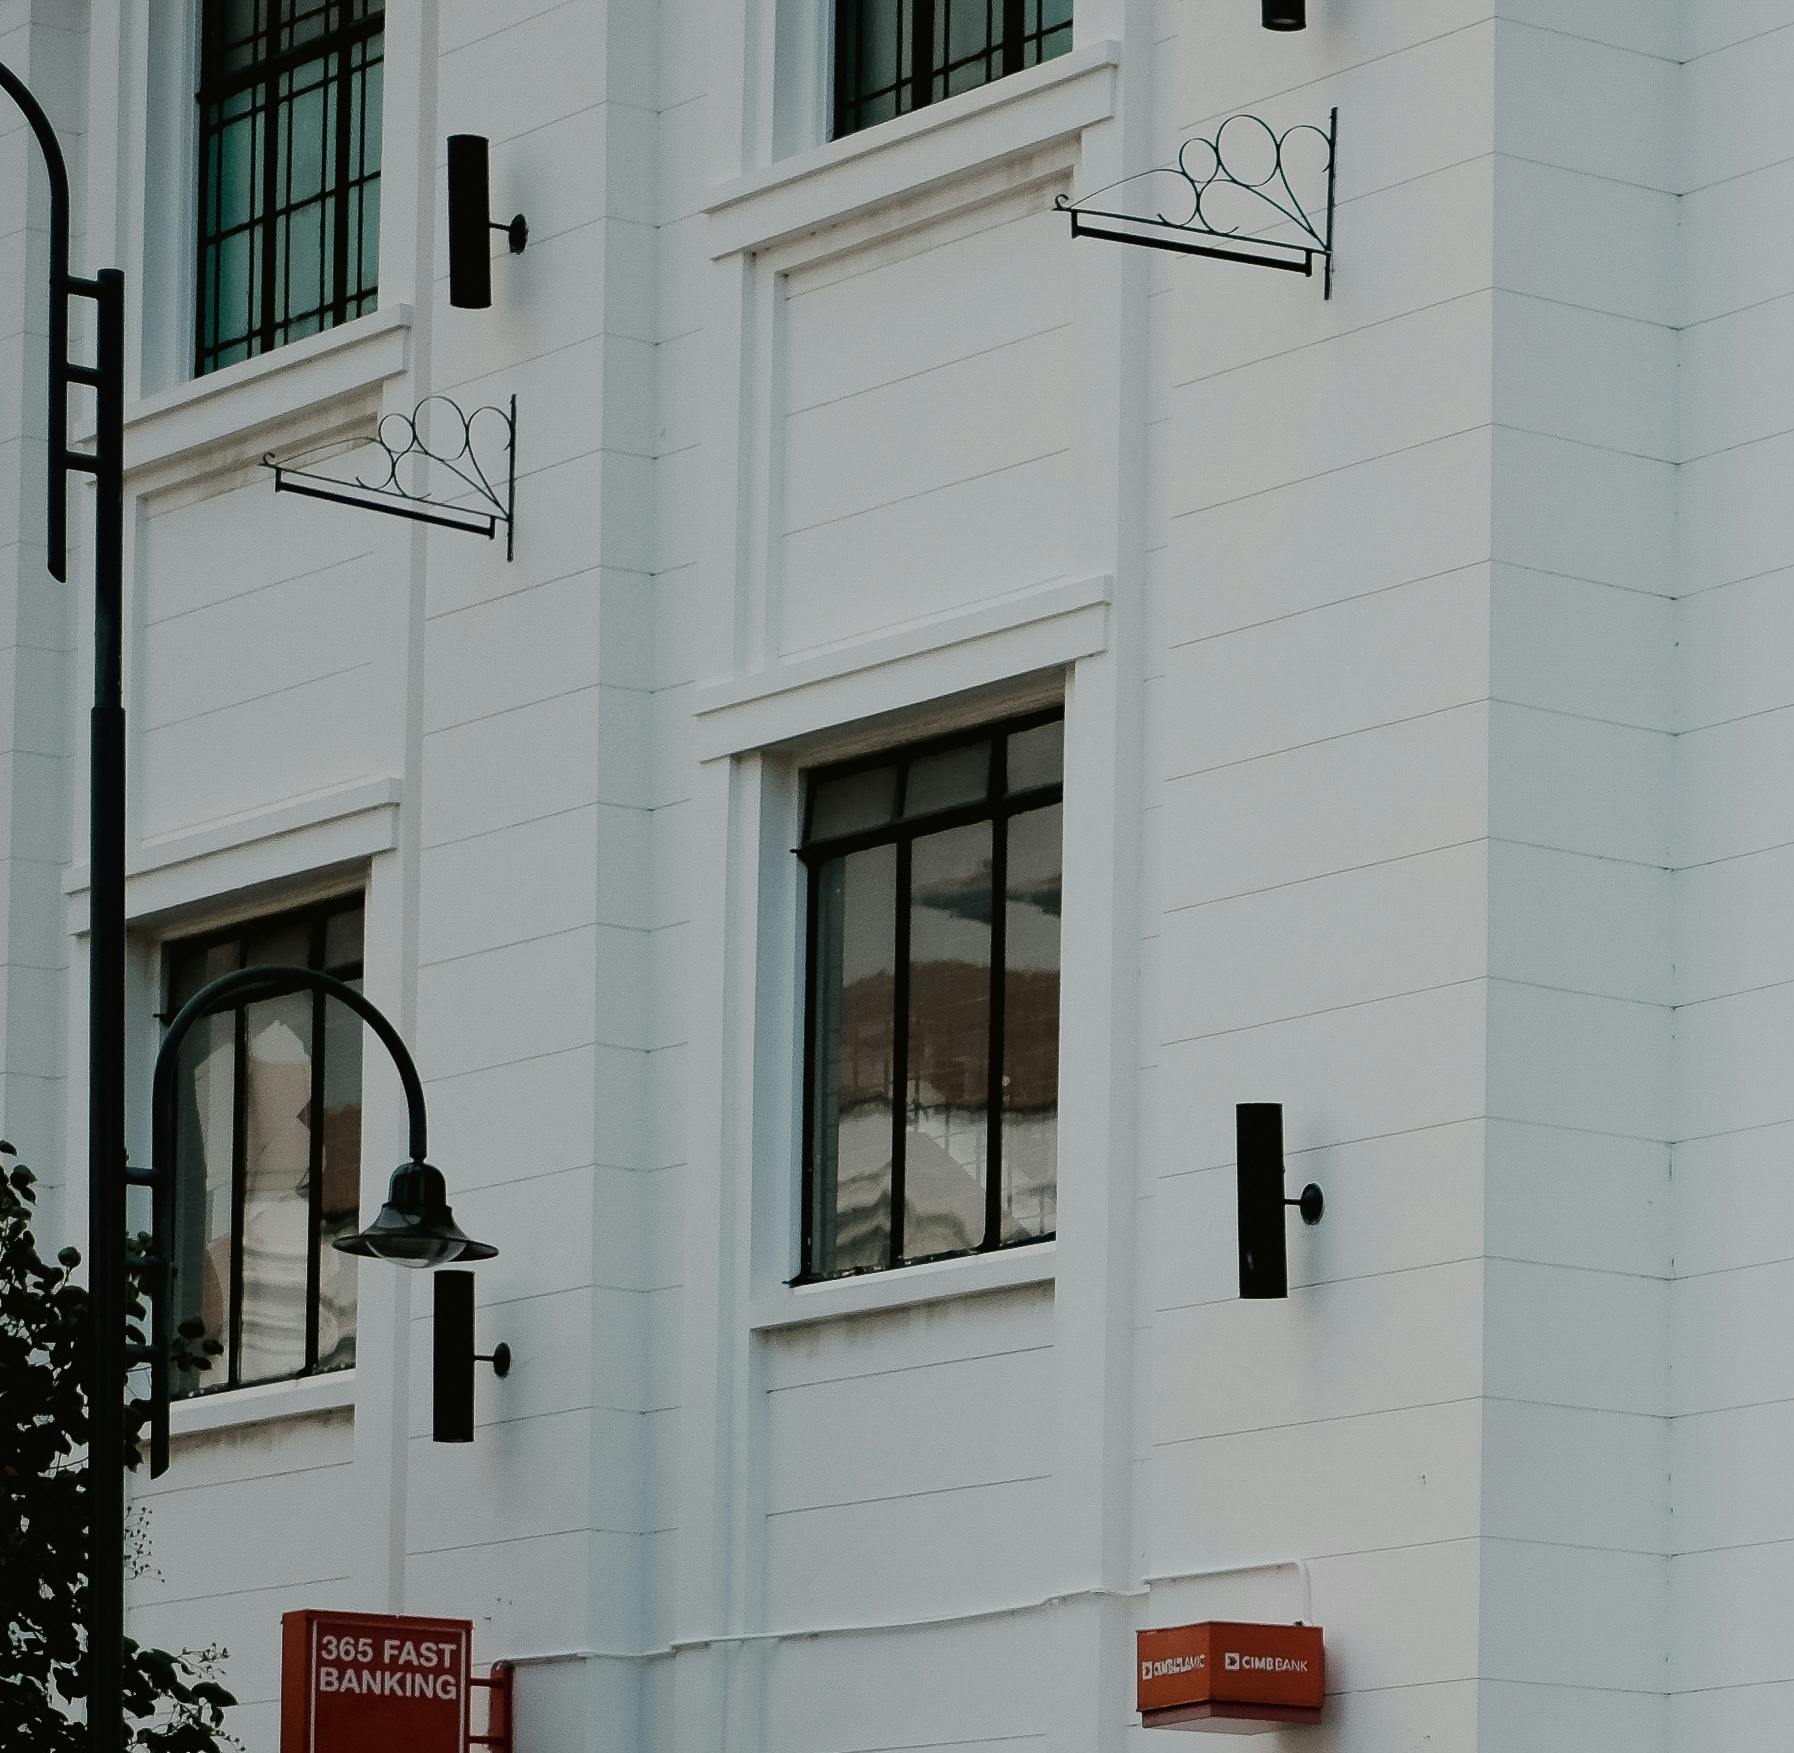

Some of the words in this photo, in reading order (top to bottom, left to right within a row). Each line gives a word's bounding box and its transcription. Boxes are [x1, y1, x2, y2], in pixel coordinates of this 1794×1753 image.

[321, 1635, 374, 1662] 365
[383, 1639, 457, 1668] FAST
[1241, 1655, 1273, 1671] CIMB
[1275, 1657, 1308, 1672] BANK
[319, 1666, 457, 1700] BANKING
